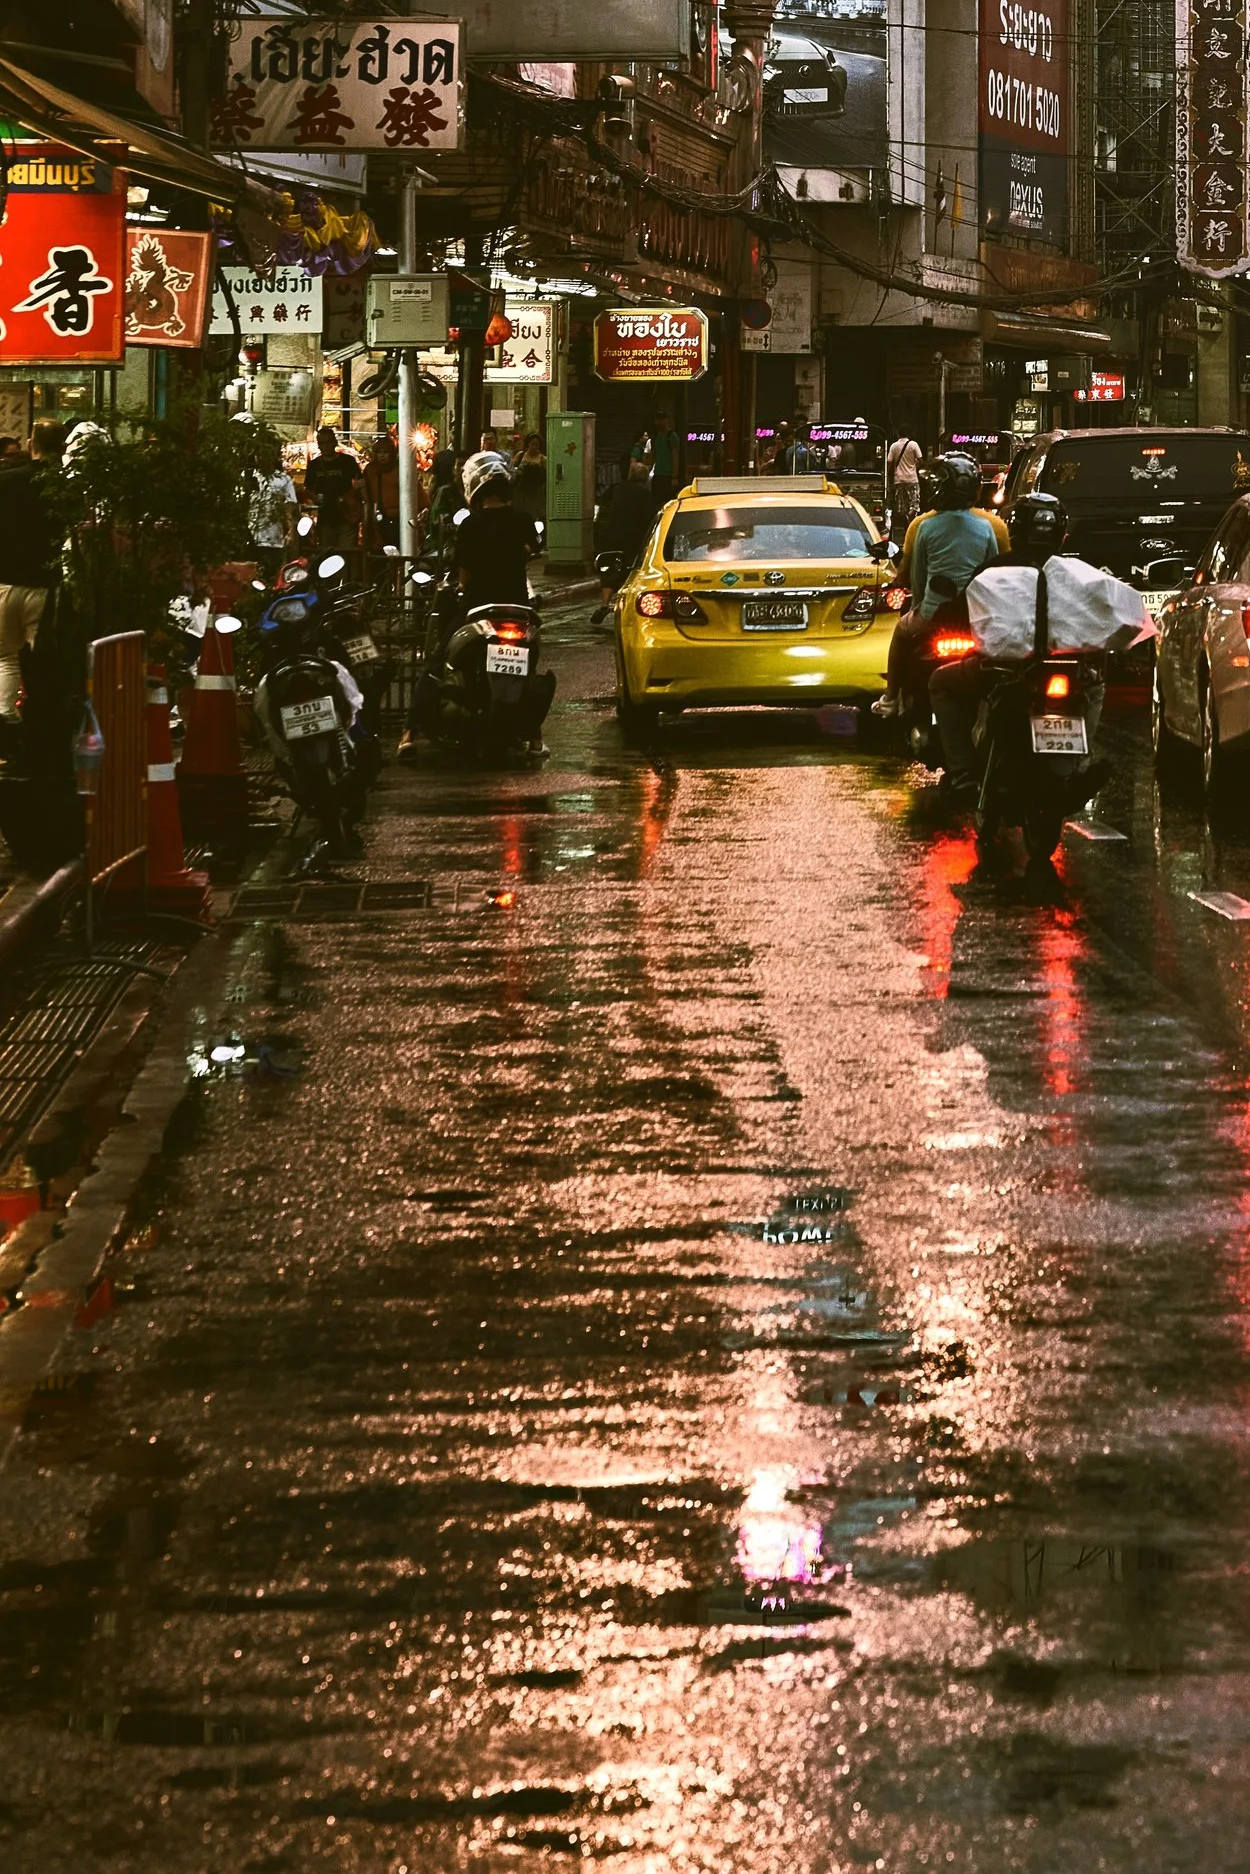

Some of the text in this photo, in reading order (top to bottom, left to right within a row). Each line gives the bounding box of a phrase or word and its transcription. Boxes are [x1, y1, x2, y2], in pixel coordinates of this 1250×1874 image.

[1036, 86, 1060, 138] 5020
[1010, 180, 1043, 218] nexus
[617, 312, 687, 338] ทองใบ
[495, 663, 522, 674] 7289
[1047, 741, 1074, 751] 229
